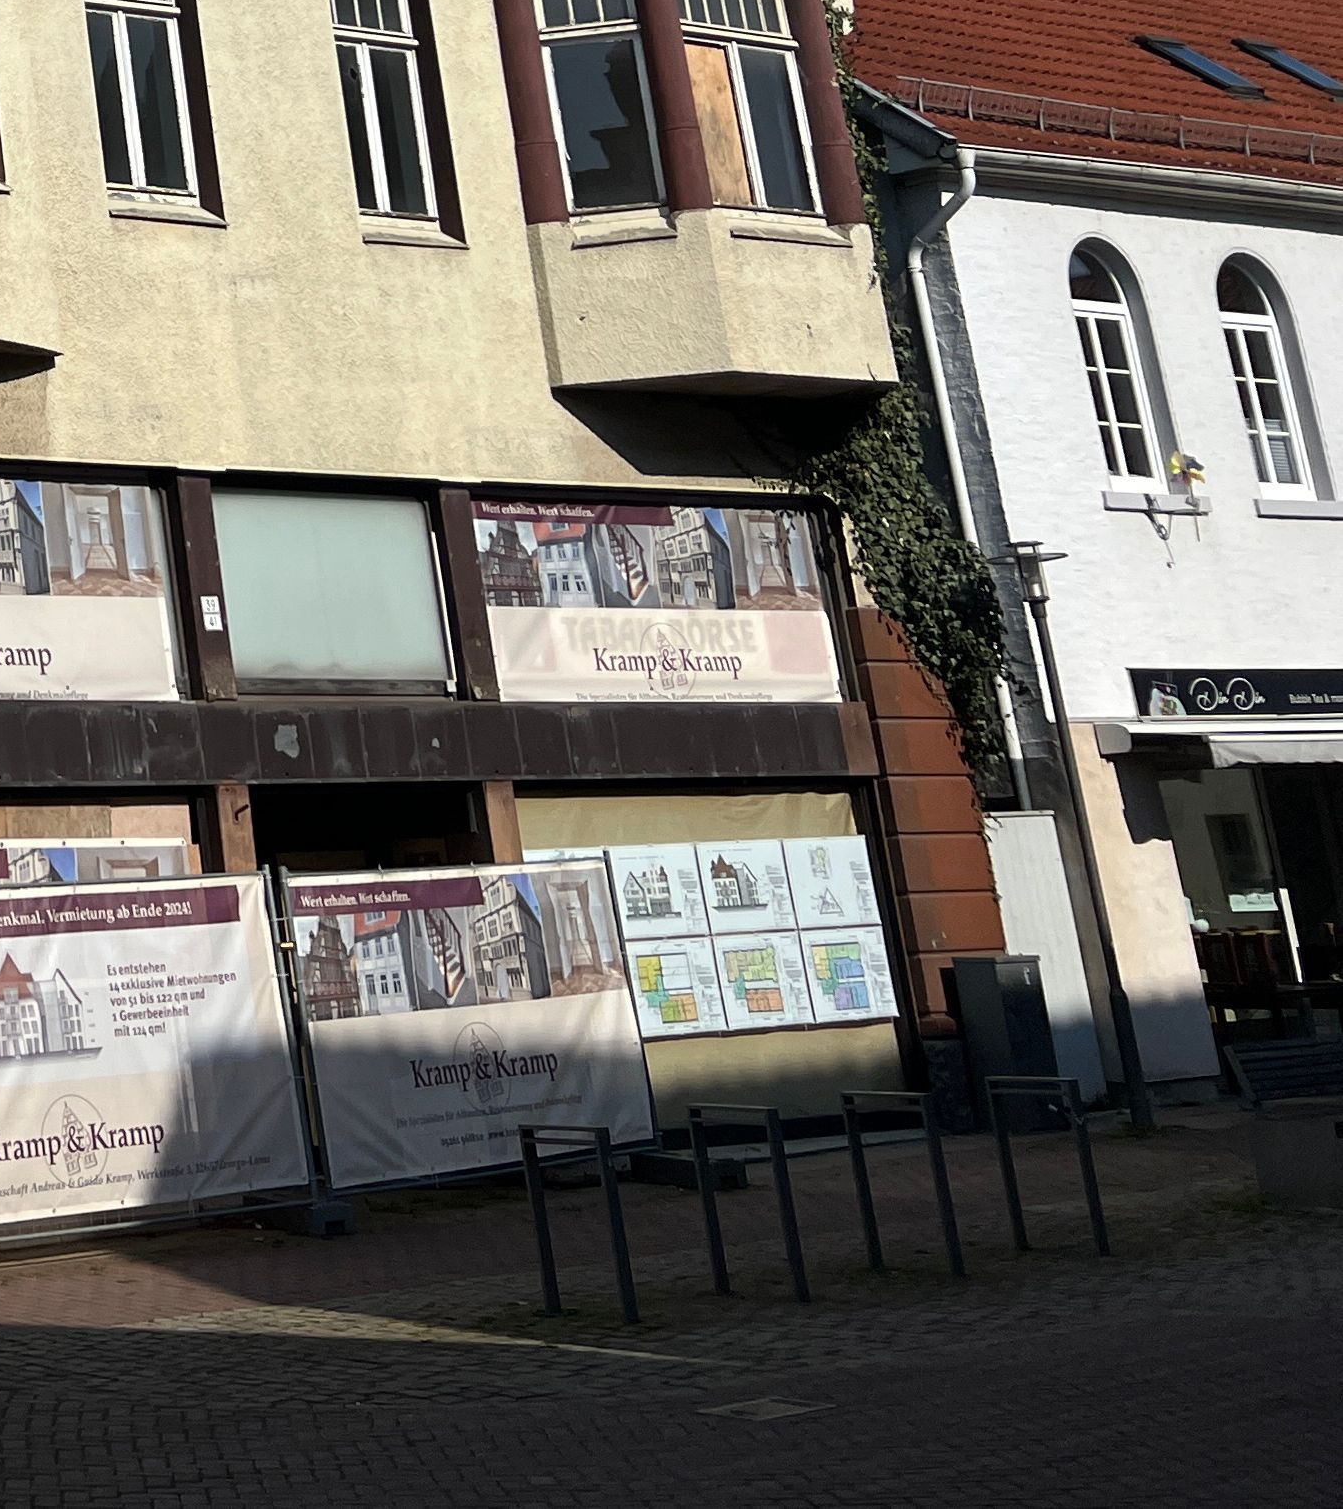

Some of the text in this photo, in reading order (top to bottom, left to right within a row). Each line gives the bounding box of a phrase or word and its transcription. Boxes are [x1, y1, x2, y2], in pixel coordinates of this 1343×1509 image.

[592, 647, 742, 679] Kramp & Kramp
[46, 907, 115, 923] Vermietung
[116, 904, 130, 919] ab
[132, 903, 162, 918] Ende
[163, 901, 192, 916] 2024!
[107, 962, 166, 976] Es entstehen
[109, 982, 120, 993] 14
[121, 976, 165, 989] exklusive
[110, 988, 205, 1007] von 51 bis 122 qm und
[113, 1006, 189, 1022] 1 Gewerbeeinheit
[114, 1025, 130, 1037] mit
[133, 1026, 147, 1036] 124
[409, 1050, 558, 1091] Kramp & Kramp
[67, 1125, 86, 1153] &
[88, 1122, 164, 1153] Kramp
